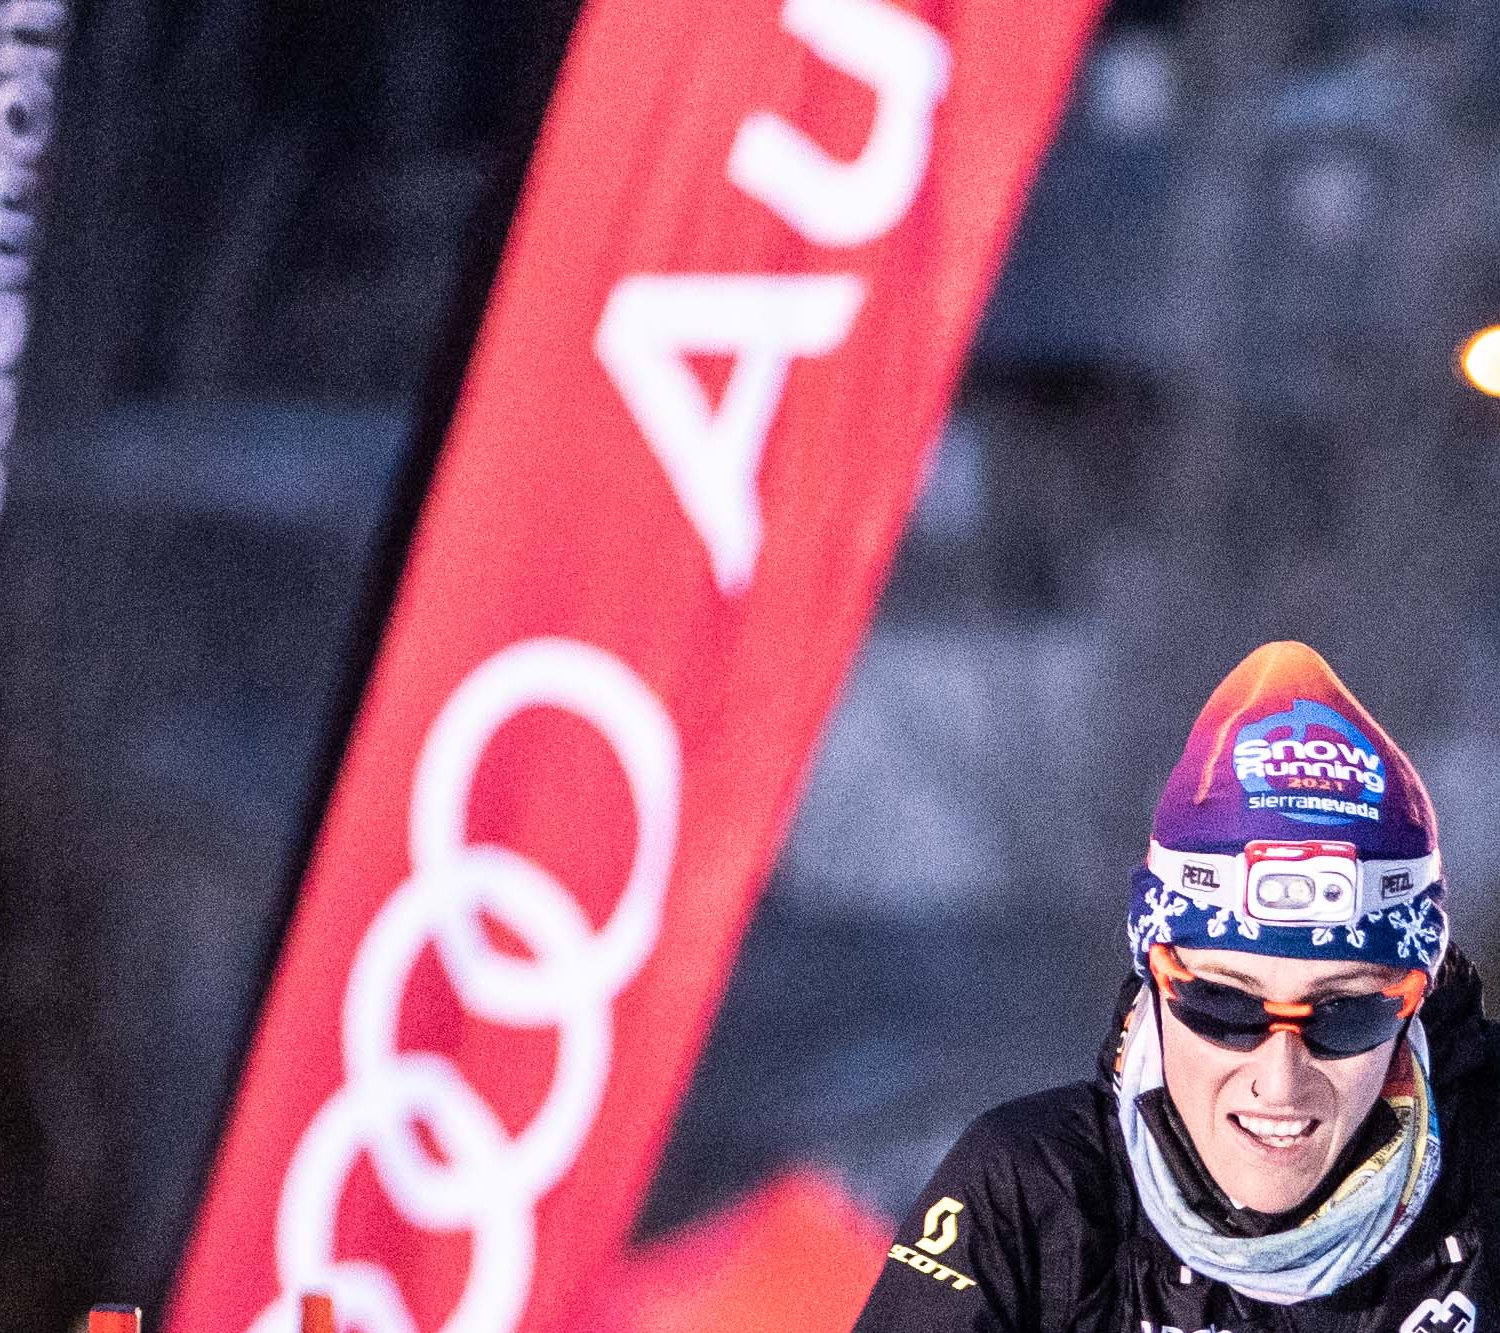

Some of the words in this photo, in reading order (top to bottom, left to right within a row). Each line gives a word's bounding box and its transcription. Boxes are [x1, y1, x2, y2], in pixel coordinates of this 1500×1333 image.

[1233, 738, 1380, 771] Snow
[1235, 758, 1385, 794] Running
[1287, 777, 1344, 793] 2021
[1182, 863, 1221, 889] PETZL
[1381, 871, 1414, 898] PETZL
[888, 1243, 978, 1292] SCOTT
